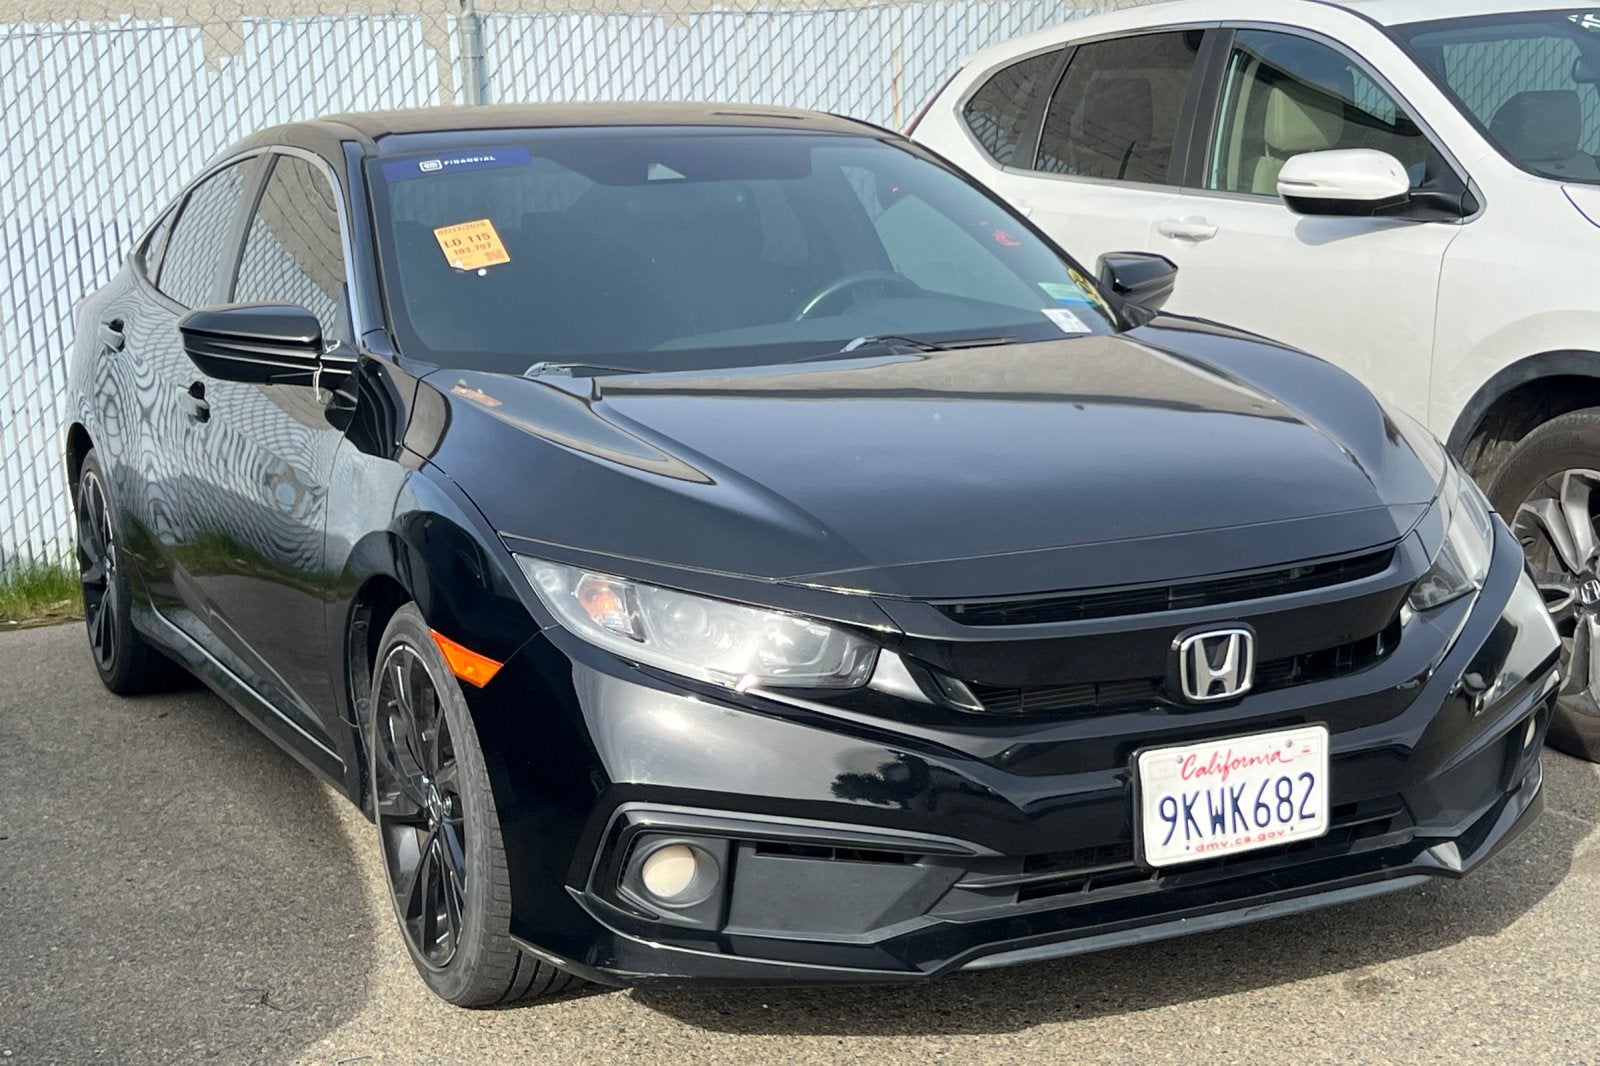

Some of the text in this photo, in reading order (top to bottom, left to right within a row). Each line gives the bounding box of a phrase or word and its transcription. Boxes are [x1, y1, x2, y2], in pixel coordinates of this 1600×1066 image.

[444, 156, 496, 166] FINANCIAL
[444, 232, 491, 249] LD 115
[1181, 749, 1293, 782] California
[1158, 771, 1316, 847] 9KWK682
[1195, 829, 1285, 852] dmv.ca.gov
